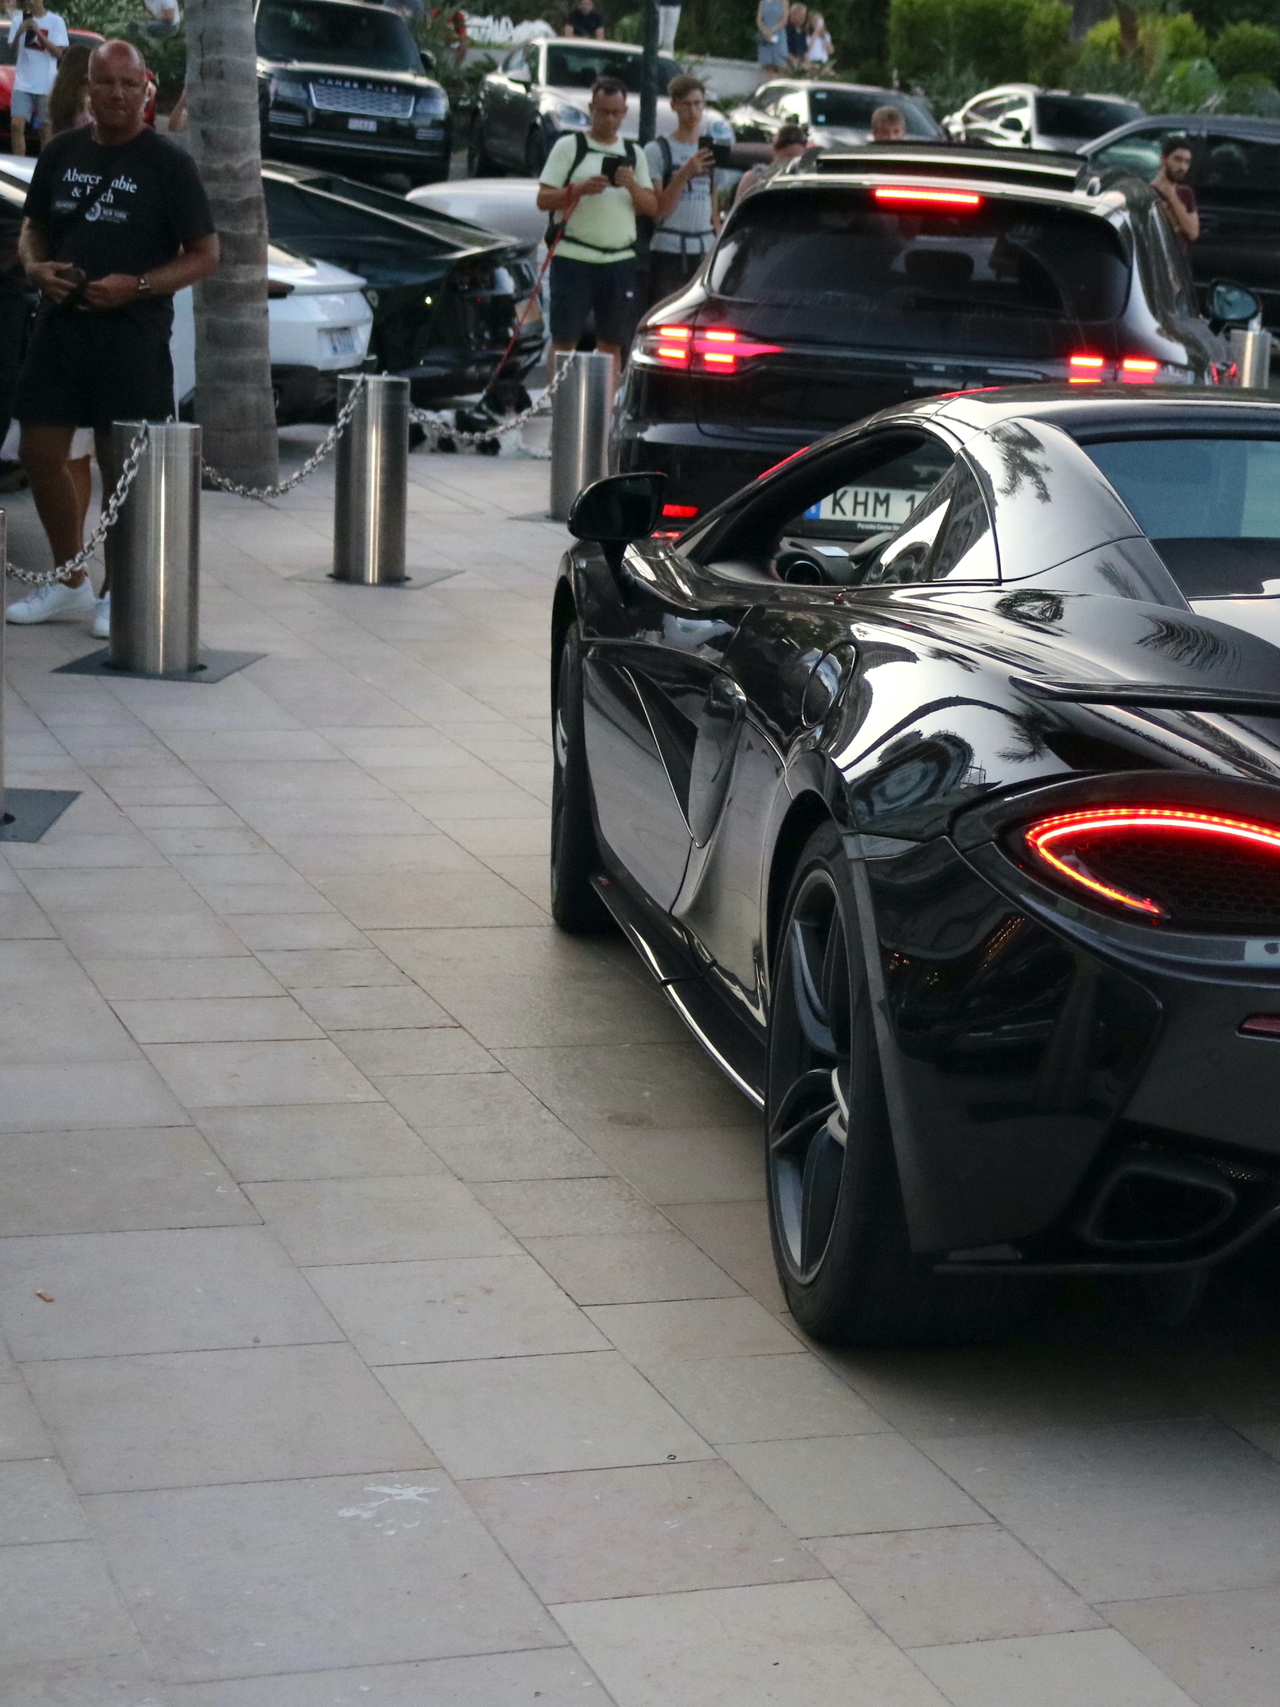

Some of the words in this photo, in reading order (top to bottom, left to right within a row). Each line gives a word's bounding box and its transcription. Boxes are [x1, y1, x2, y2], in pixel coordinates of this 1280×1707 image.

[62, 167, 138, 193] Abercrmbie
[71, 186, 82, 198] &
[86, 185, 114, 203] Fch
[832, 490, 891, 518] KHM
